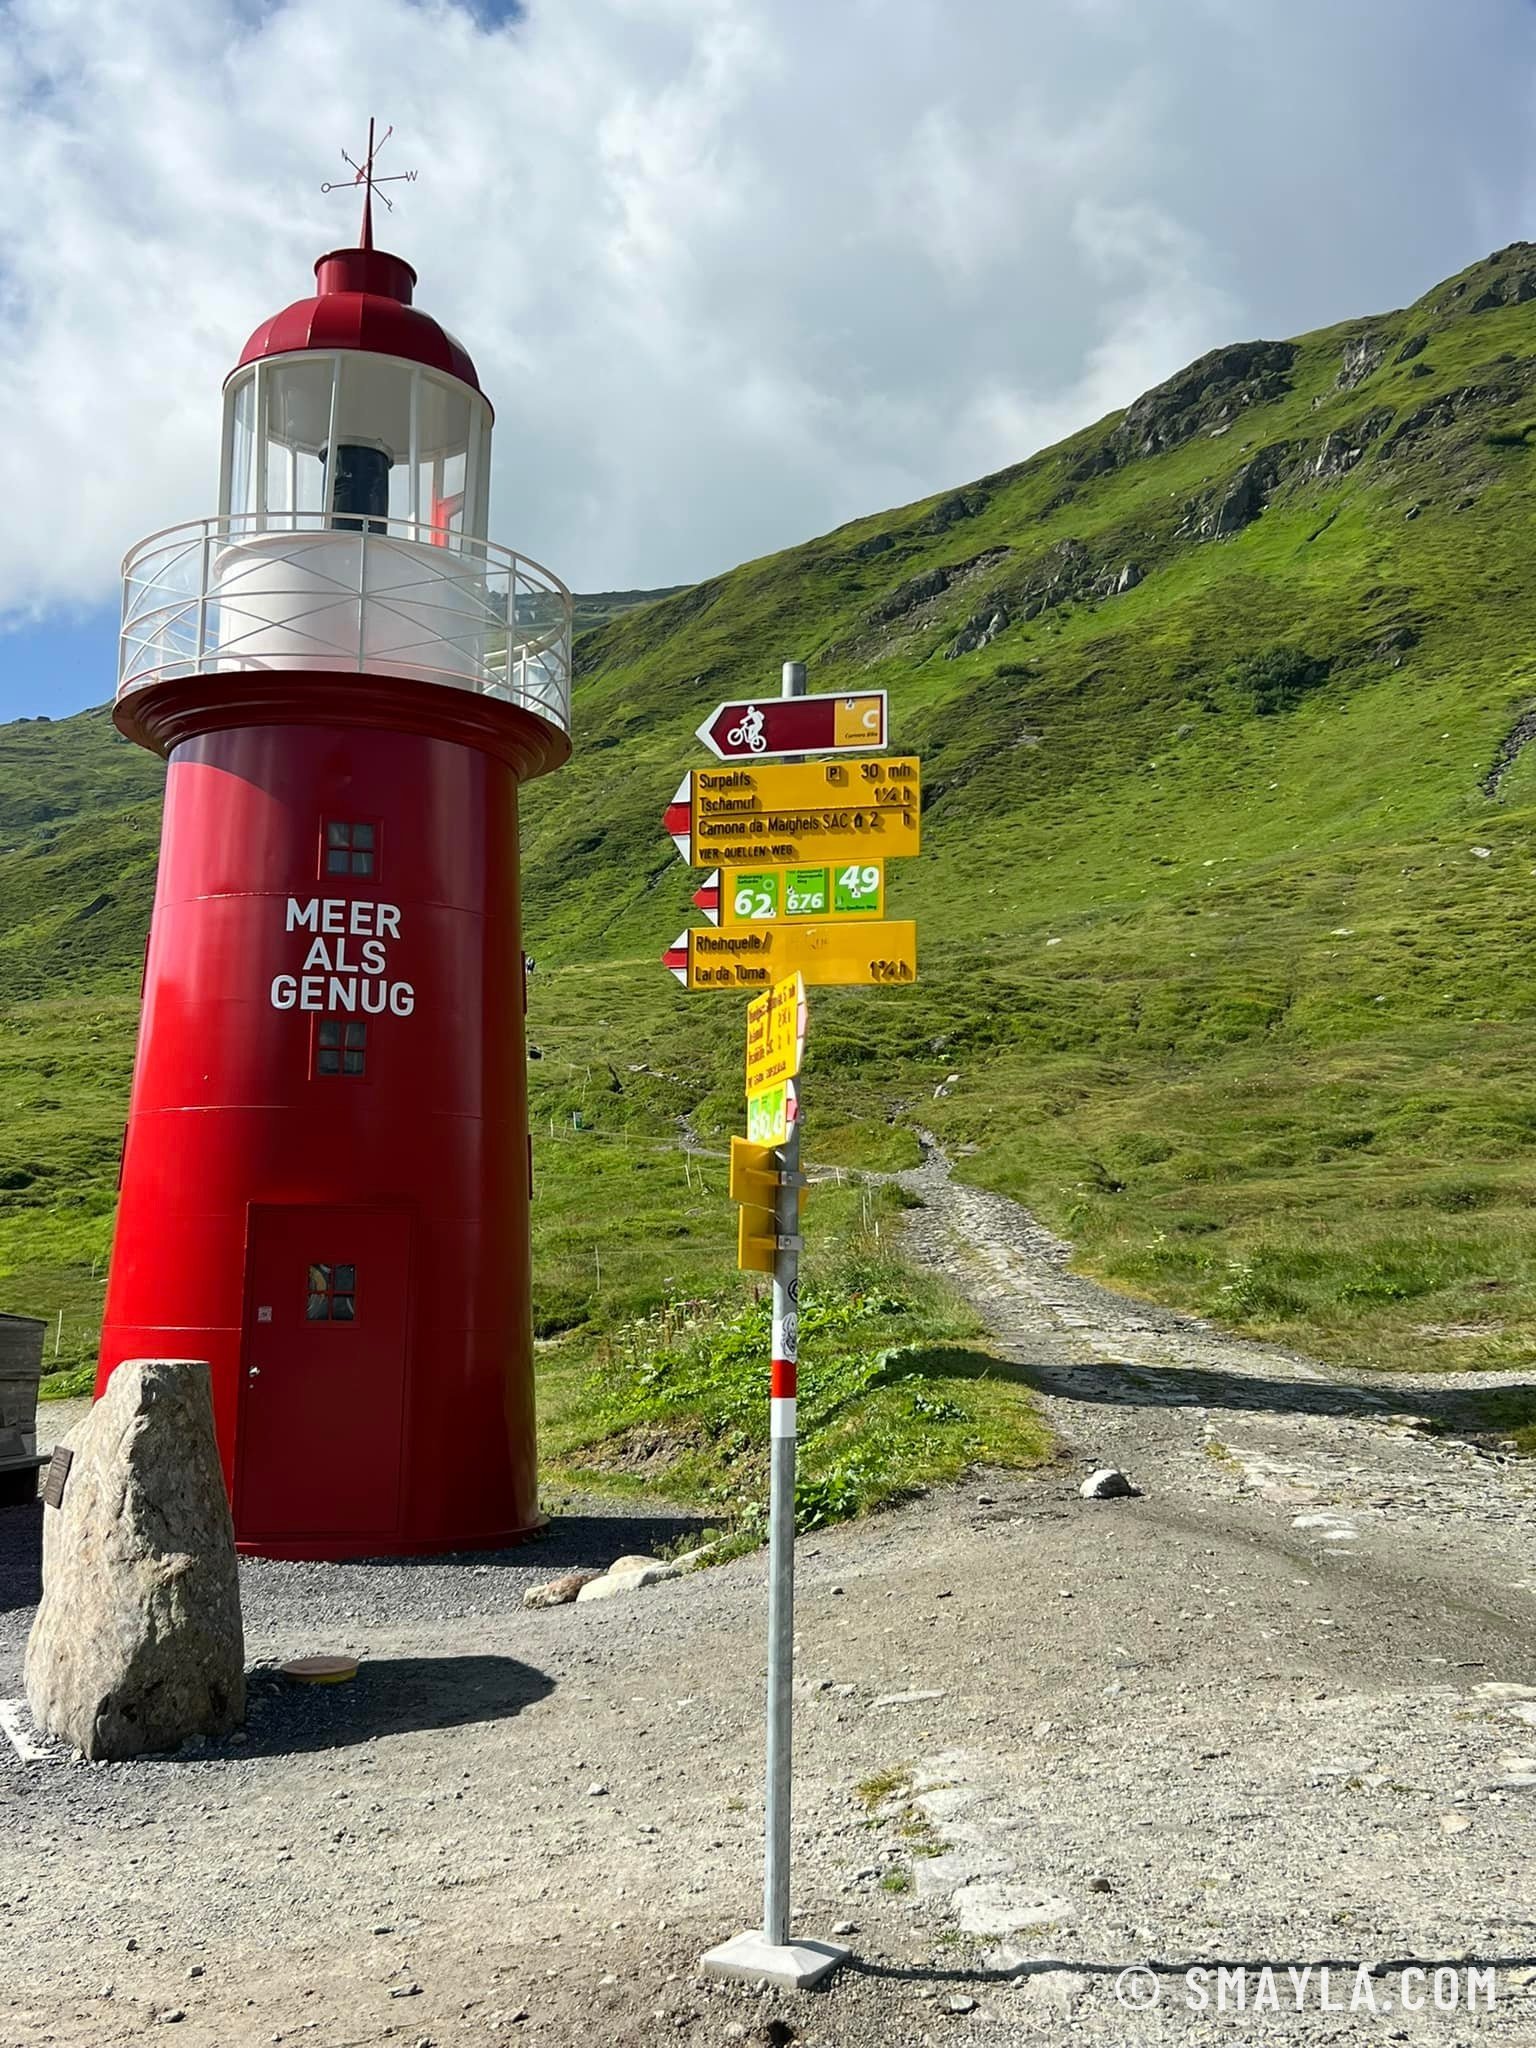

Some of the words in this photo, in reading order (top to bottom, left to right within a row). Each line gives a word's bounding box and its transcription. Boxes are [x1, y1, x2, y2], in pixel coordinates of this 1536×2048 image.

[862, 709, 880, 729] C
[861, 763, 879, 779] 30
[888, 762, 911, 778] min
[903, 785, 910, 800] h
[698, 820, 745, 837] Camona
[749, 818, 763, 833] da
[768, 815, 819, 835] Maighels
[822, 812, 848, 829] SAC
[870, 811, 879, 827] 2
[903, 808, 910, 826] h
[839, 865, 879, 893] 49
[735, 889, 776, 919] 62
[787, 893, 823, 909] 676
[286, 898, 401, 939] MEER
[302, 937, 386, 975] ALS
[716, 966, 729, 981] da
[734, 964, 766, 980] Tuma
[900, 960, 906, 976] h
[271, 975, 414, 1016] GENUG
